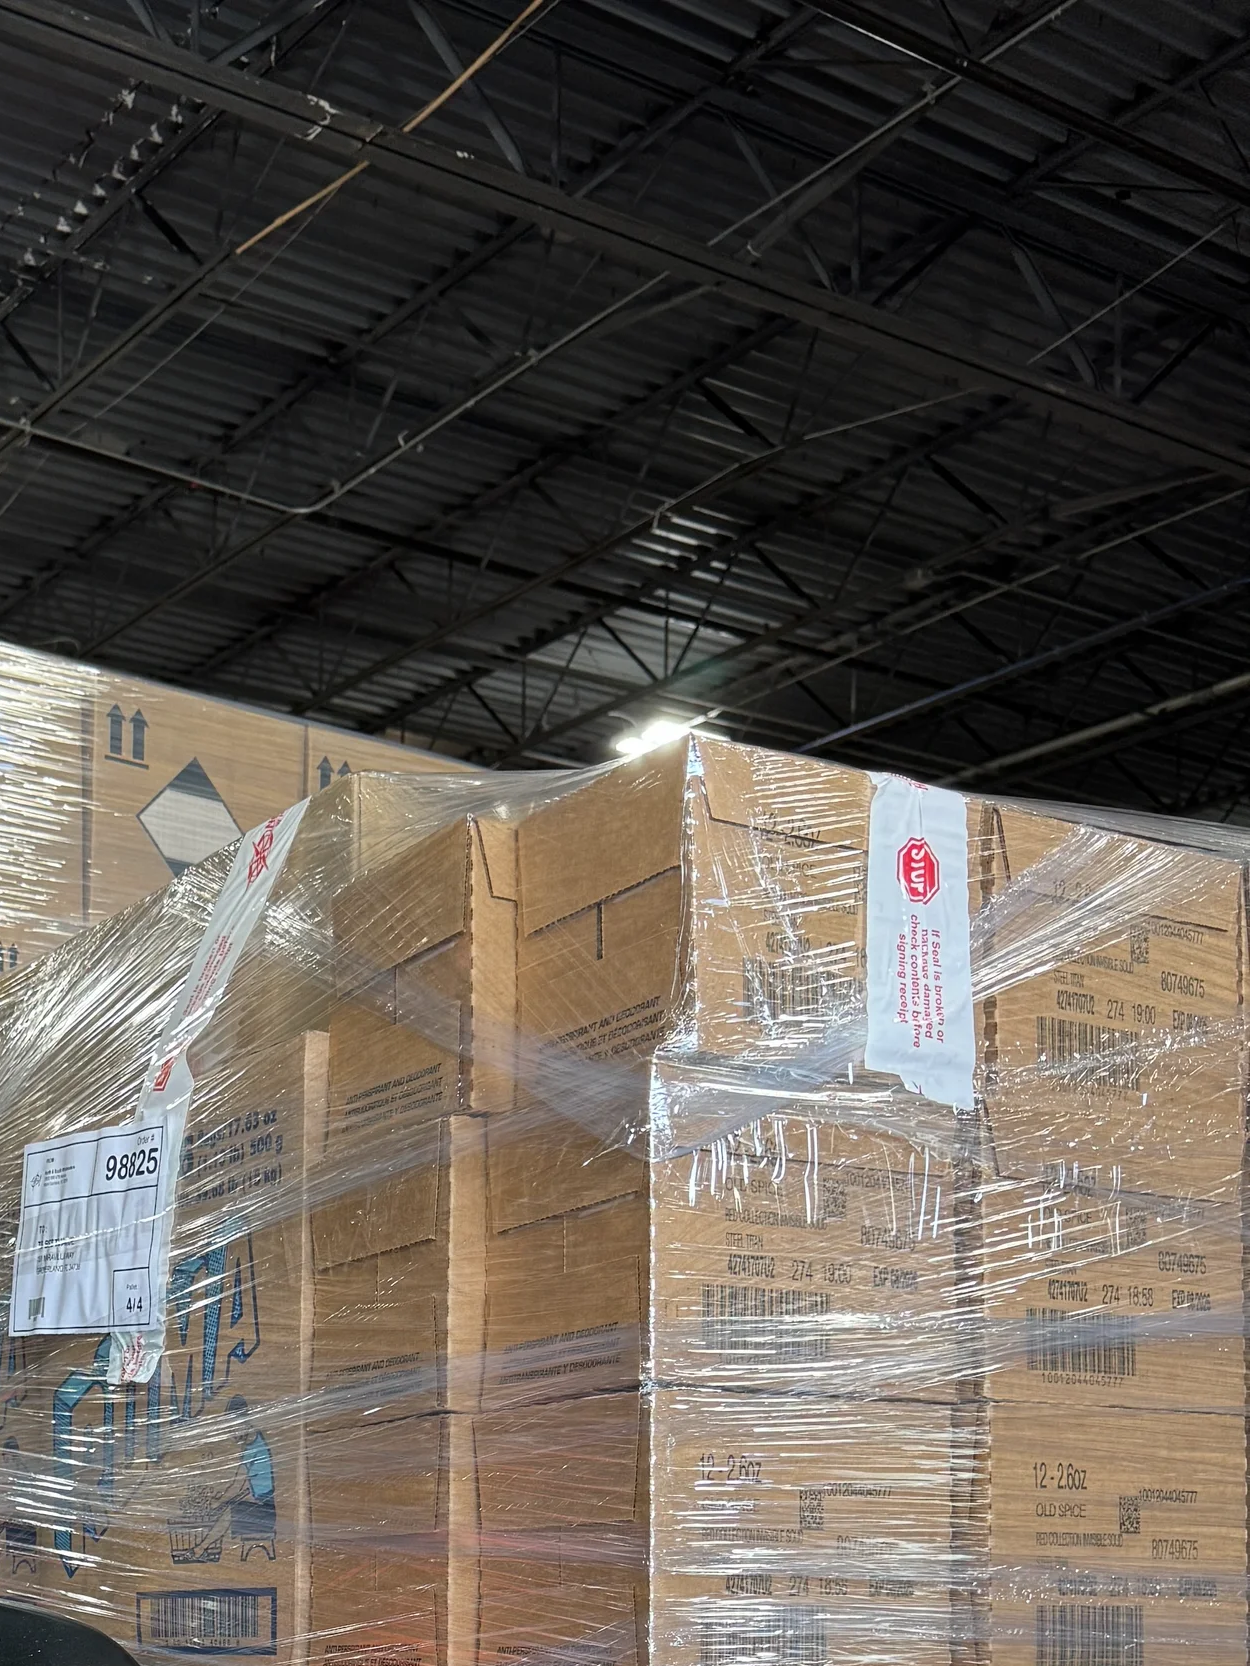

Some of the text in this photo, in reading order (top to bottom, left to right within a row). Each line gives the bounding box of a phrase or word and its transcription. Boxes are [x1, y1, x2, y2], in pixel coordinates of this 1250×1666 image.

[911, 914, 921, 951] check
[930, 929, 941, 938] If
[897, 933, 908, 978] signing
[932, 941, 943, 967] Seal
[934, 971, 943, 981] is
[1160, 971, 1205, 999] 80749675
[1107, 1000, 1124, 1021] 274
[1132, 1003, 1156, 1025] 19:00
[936, 1029, 945, 1043] or
[264, 1110, 277, 1125] oz
[250, 1133, 272, 1156] 500
[275, 1134, 283, 1154] g
[105, 1147, 158, 1181] 98825
[725, 1177, 747, 1192] OLD
[792, 1260, 813, 1282] 274
[1158, 1251, 1207, 1275] 80749675
[126, 1297, 143, 1312] 4/4
[1102, 1284, 1120, 1305] 274
[1042, 1372, 1125, 1388] 10012044045777
[1036, 1502, 1087, 1518] OLD SPICE
[1036, 1532, 1049, 1547] RED
[1049, 1532, 1082, 1548] COLLECTION
[1151, 1538, 1199, 1560] 80749675
